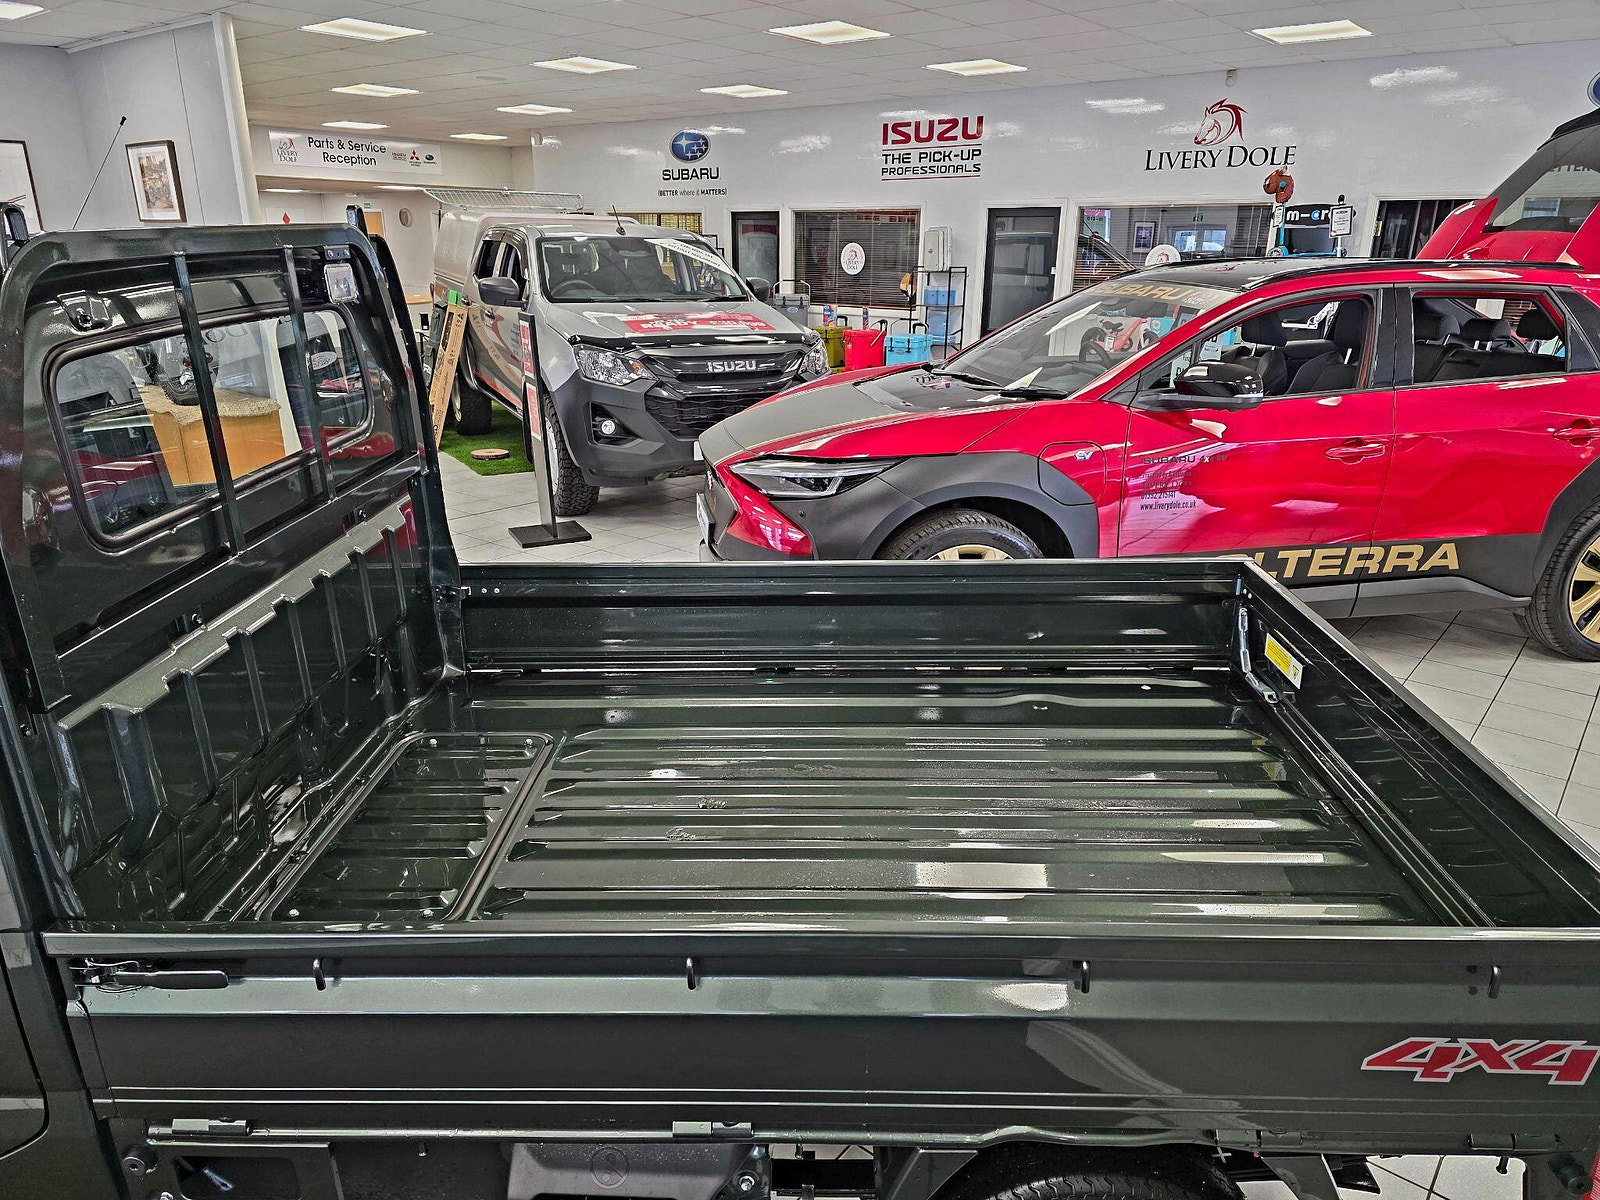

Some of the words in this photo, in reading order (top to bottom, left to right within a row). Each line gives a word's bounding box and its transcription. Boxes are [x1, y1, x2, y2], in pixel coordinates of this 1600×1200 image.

[882, 115, 984, 145] ISUZU
[308, 136, 335, 150] Parts
[337, 139, 347, 150] &
[348, 140, 387, 154] Service
[322, 151, 377, 167] Reception
[881, 152, 912, 165] THE
[918, 149, 982, 164] PICK-UP
[1144, 149, 1224, 171] LIVERY
[1226, 145, 1297, 168] DOLE
[661, 166, 720, 181] SUBARU
[881, 163, 982, 176] PROFESSIONALS
[1285, 208, 1331, 221] m-cr
[706, 360, 757, 373] ISUZU
[1143, 455, 1196, 465] SUBARU
[1140, 500, 1197, 511] www.liverydole.co.uk
[1216, 543, 1460, 578] LTERRA
